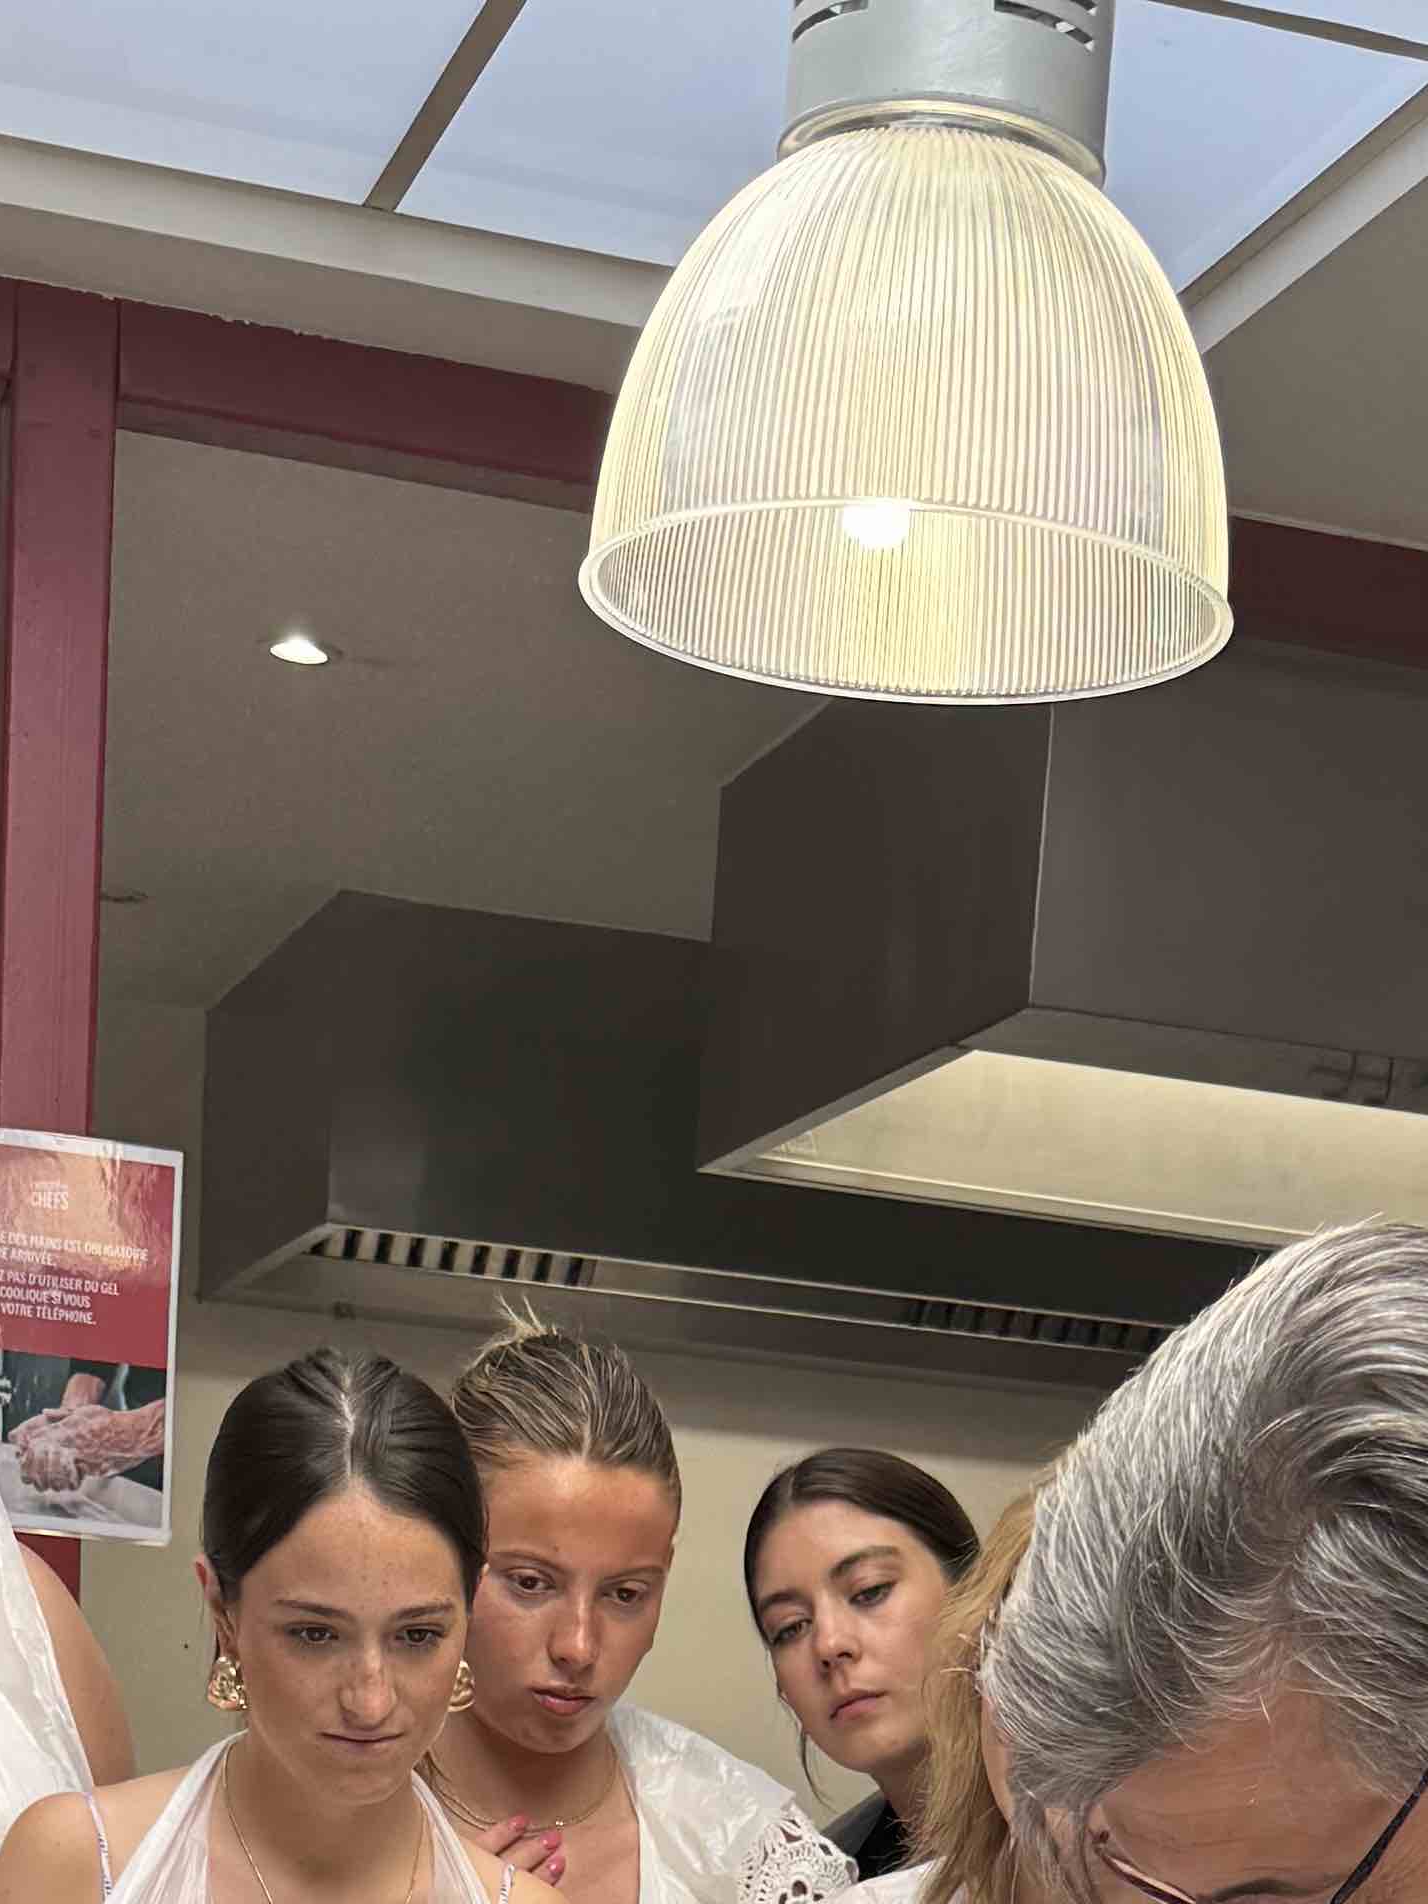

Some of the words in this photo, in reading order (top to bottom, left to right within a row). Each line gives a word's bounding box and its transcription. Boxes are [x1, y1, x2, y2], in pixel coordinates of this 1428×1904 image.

[31, 1191, 69, 1210] CHEFS
[8, 1231, 28, 1248] DES
[63, 1240, 81, 1253] EST
[6, 1271, 27, 1285] PAS
[28, 1273, 83, 1292] D'UTILISER
[84, 1280, 99, 1294] DU
[100, 1282, 121, 1297] GEL
[52, 1290, 62, 1305] SI
[63, 1294, 91, 1309] VOUS
[0, 1302, 34, 1318] VOTRE
